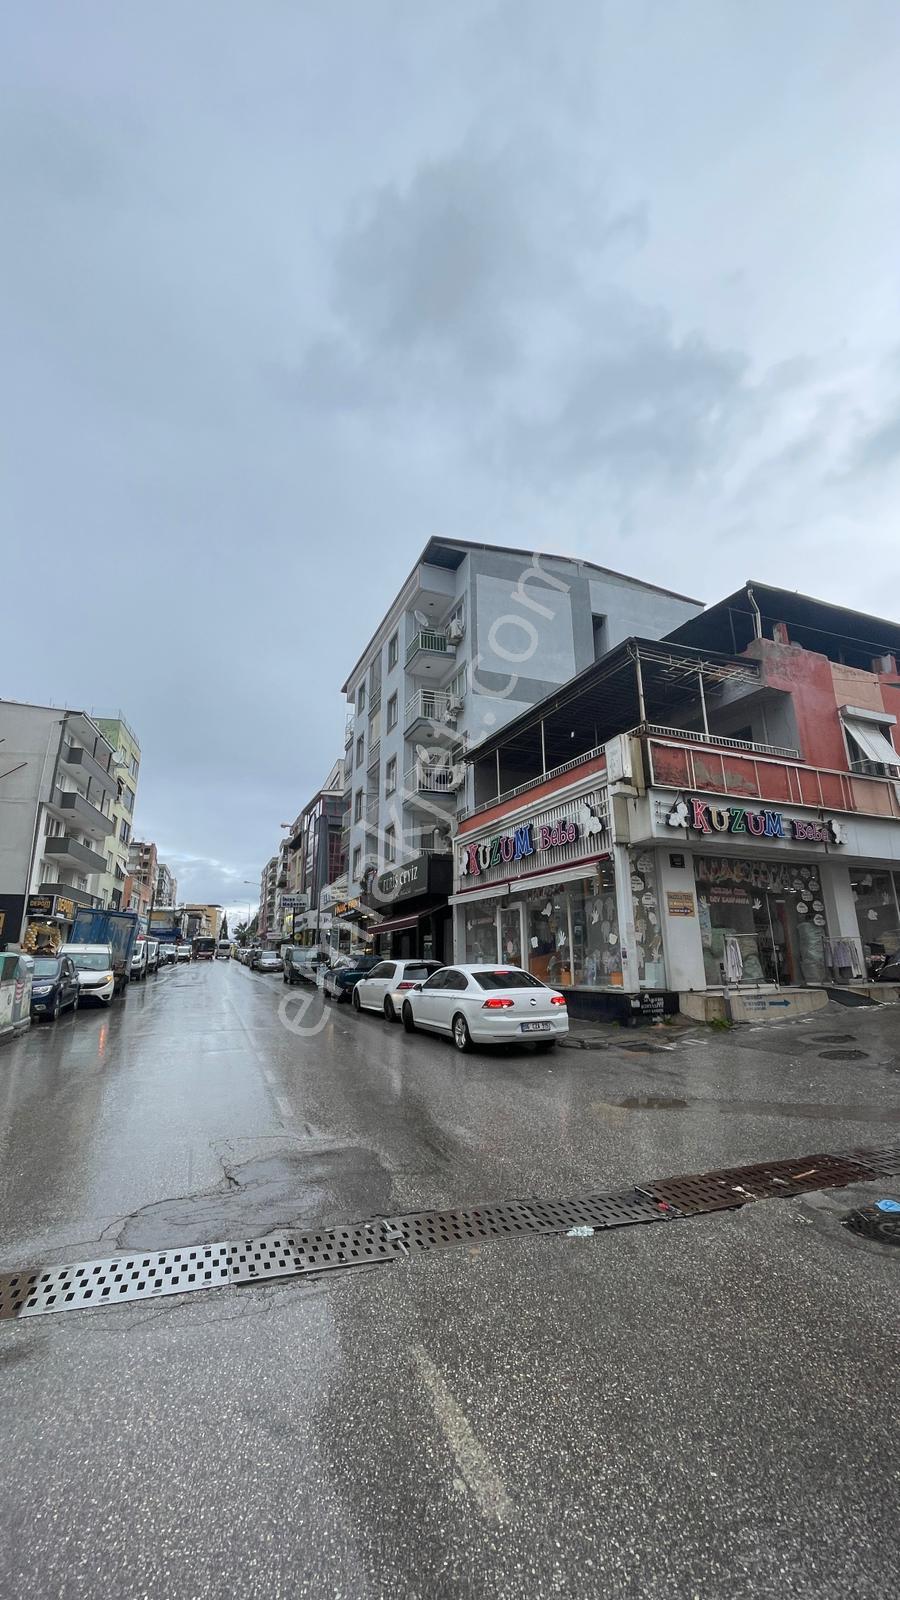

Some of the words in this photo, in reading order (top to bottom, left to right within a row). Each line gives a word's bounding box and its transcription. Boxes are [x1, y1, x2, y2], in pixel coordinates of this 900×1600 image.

[690, 798, 785, 838] KUZUM
[793, 819, 829, 843] Bebe
[467, 824, 534, 877] KUZUM
[540, 821, 578, 851] Bebe
